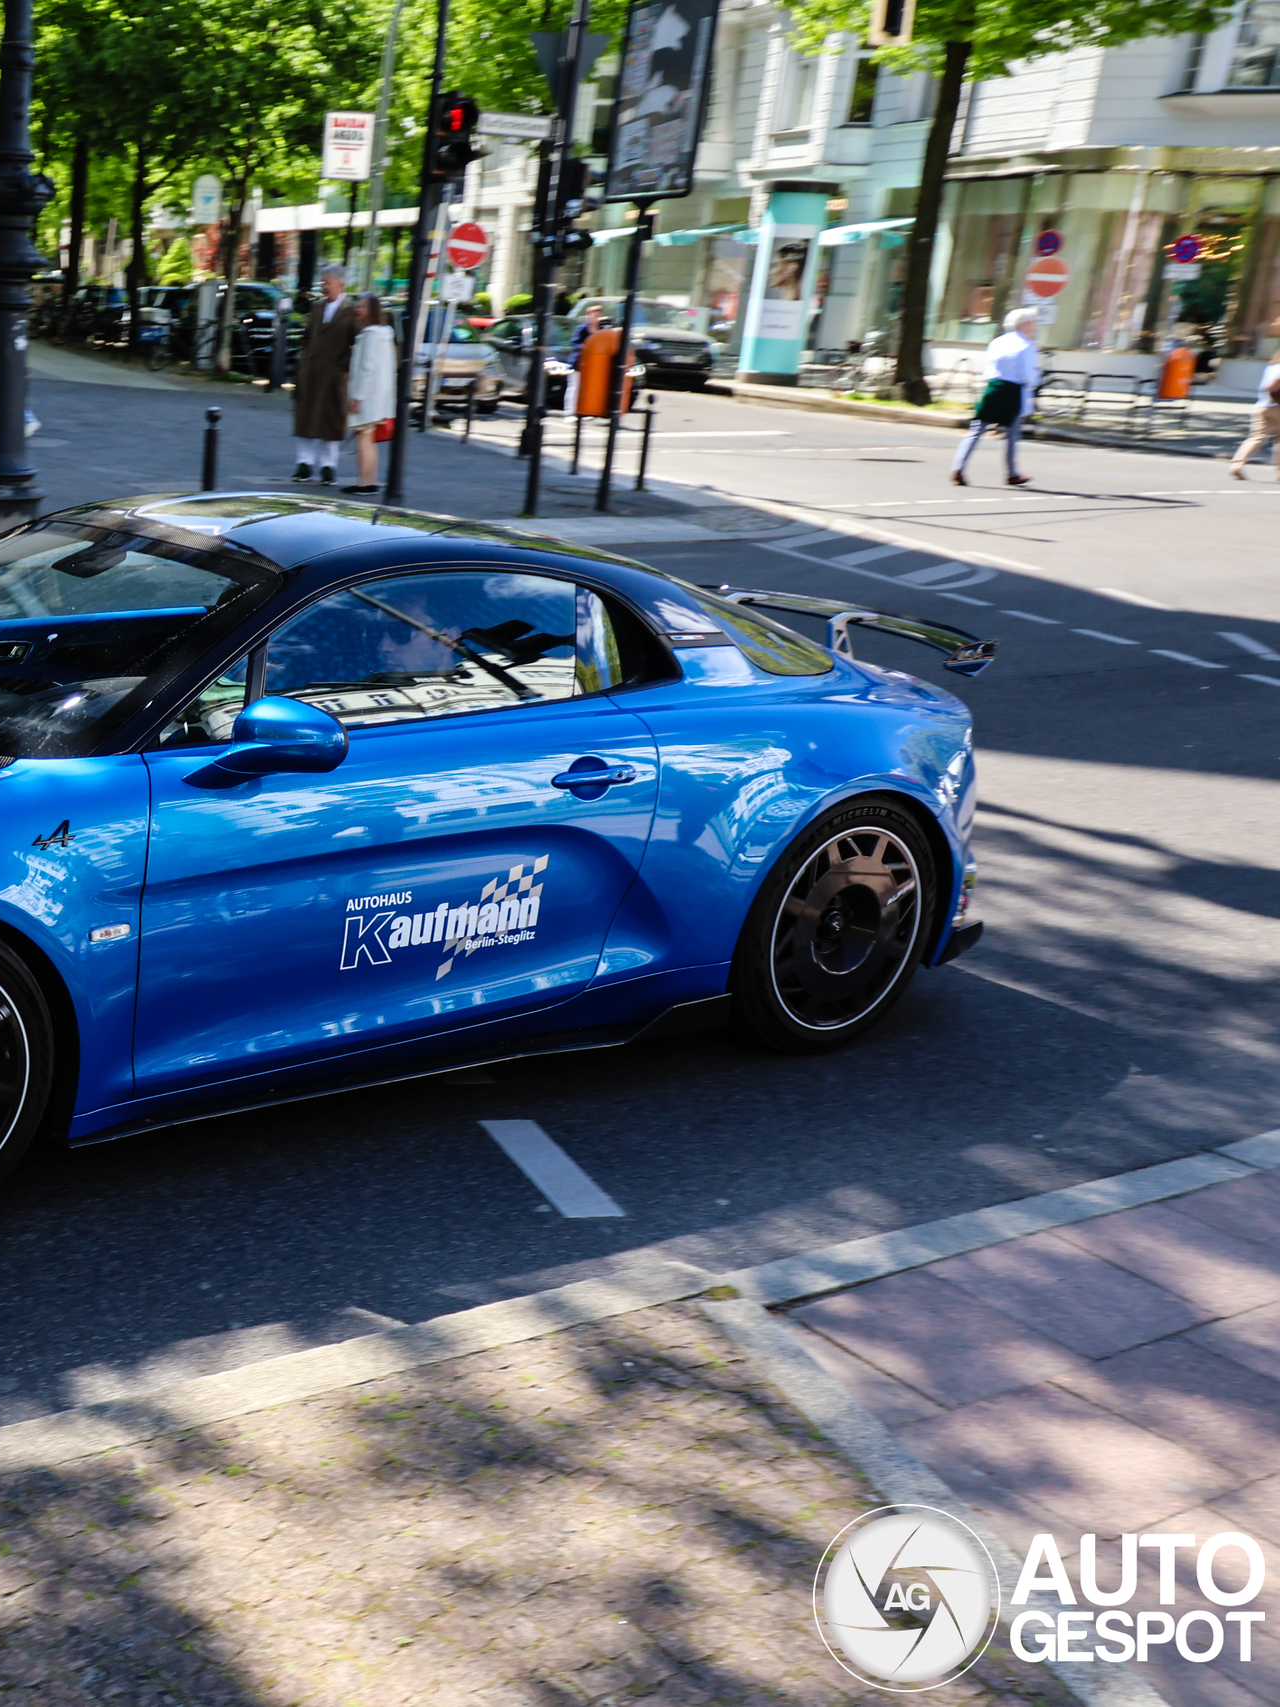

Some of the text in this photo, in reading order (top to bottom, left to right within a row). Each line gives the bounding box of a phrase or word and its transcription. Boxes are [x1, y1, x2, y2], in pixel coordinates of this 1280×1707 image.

[832, 807, 888, 827] MICHELIN
[346, 890, 413, 912] AUTOHAUS
[339, 895, 541, 971] Kaufmann
[464, 929, 536, 951] Berlin-Steglitz
